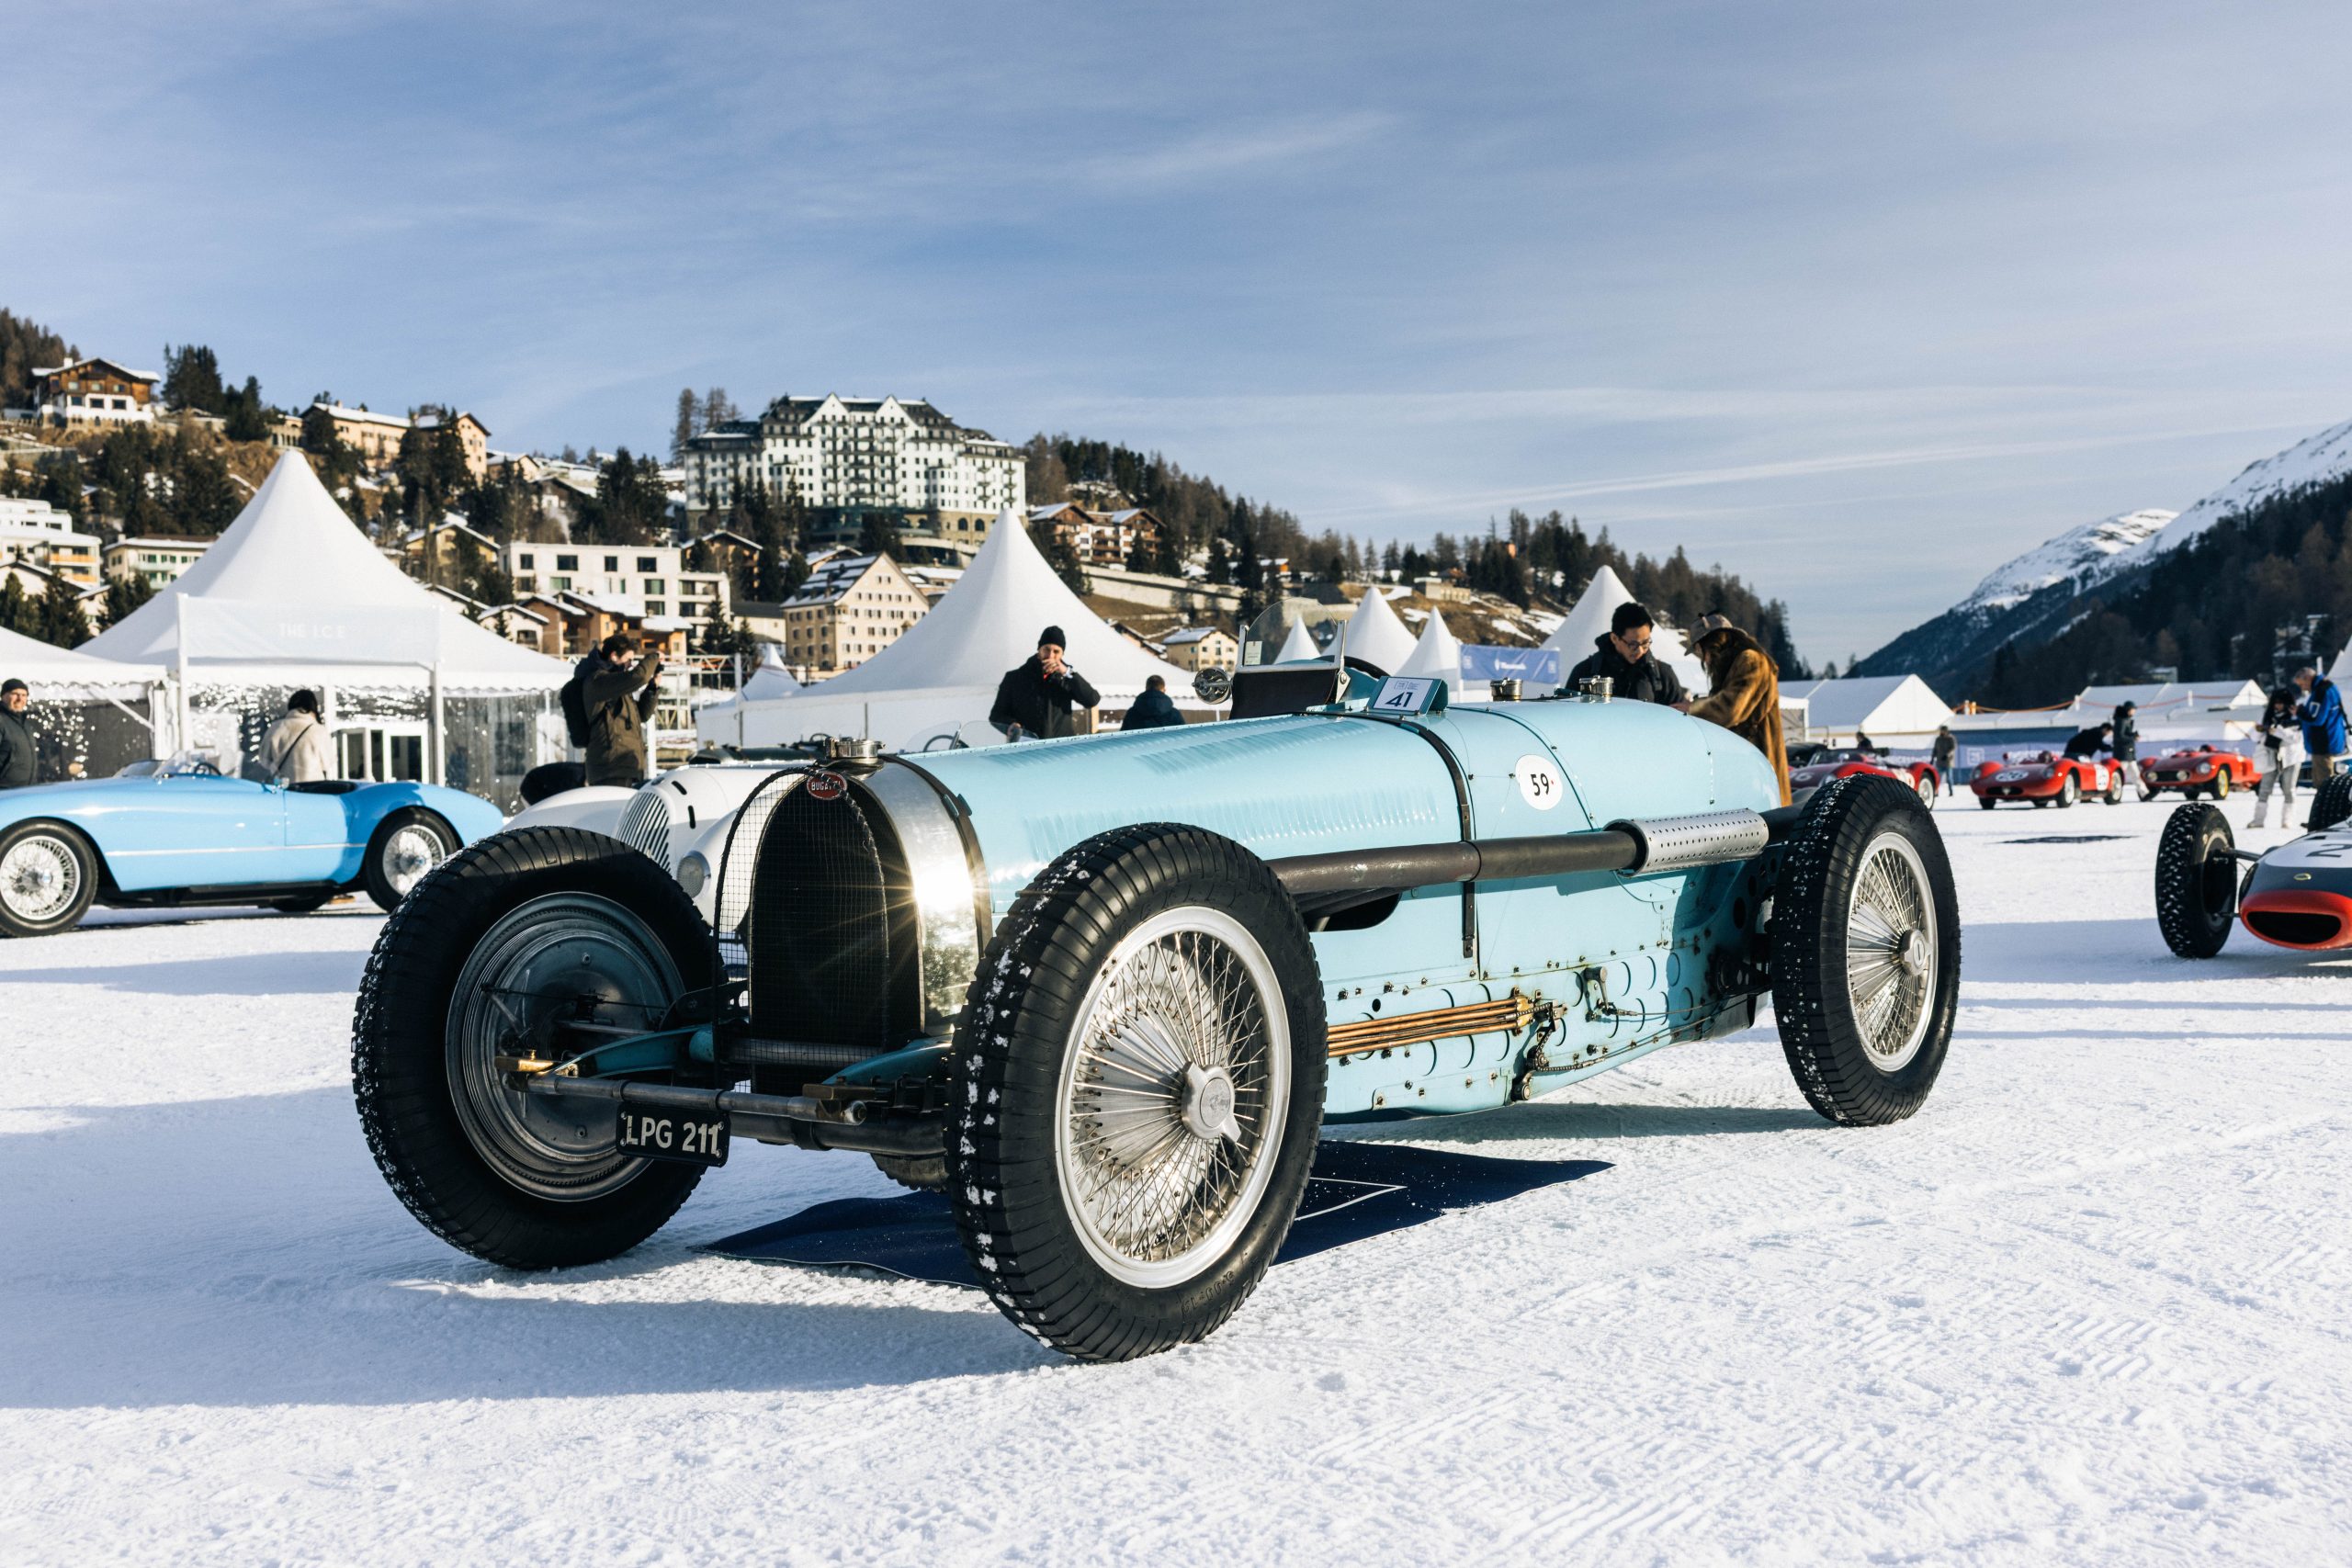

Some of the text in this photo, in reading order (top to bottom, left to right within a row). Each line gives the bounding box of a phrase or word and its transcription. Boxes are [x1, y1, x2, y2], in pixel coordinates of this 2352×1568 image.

[1385, 691, 1414, 708] 41
[1530, 773, 1550, 796] 59
[626, 1115, 719, 1156] LPG 211
